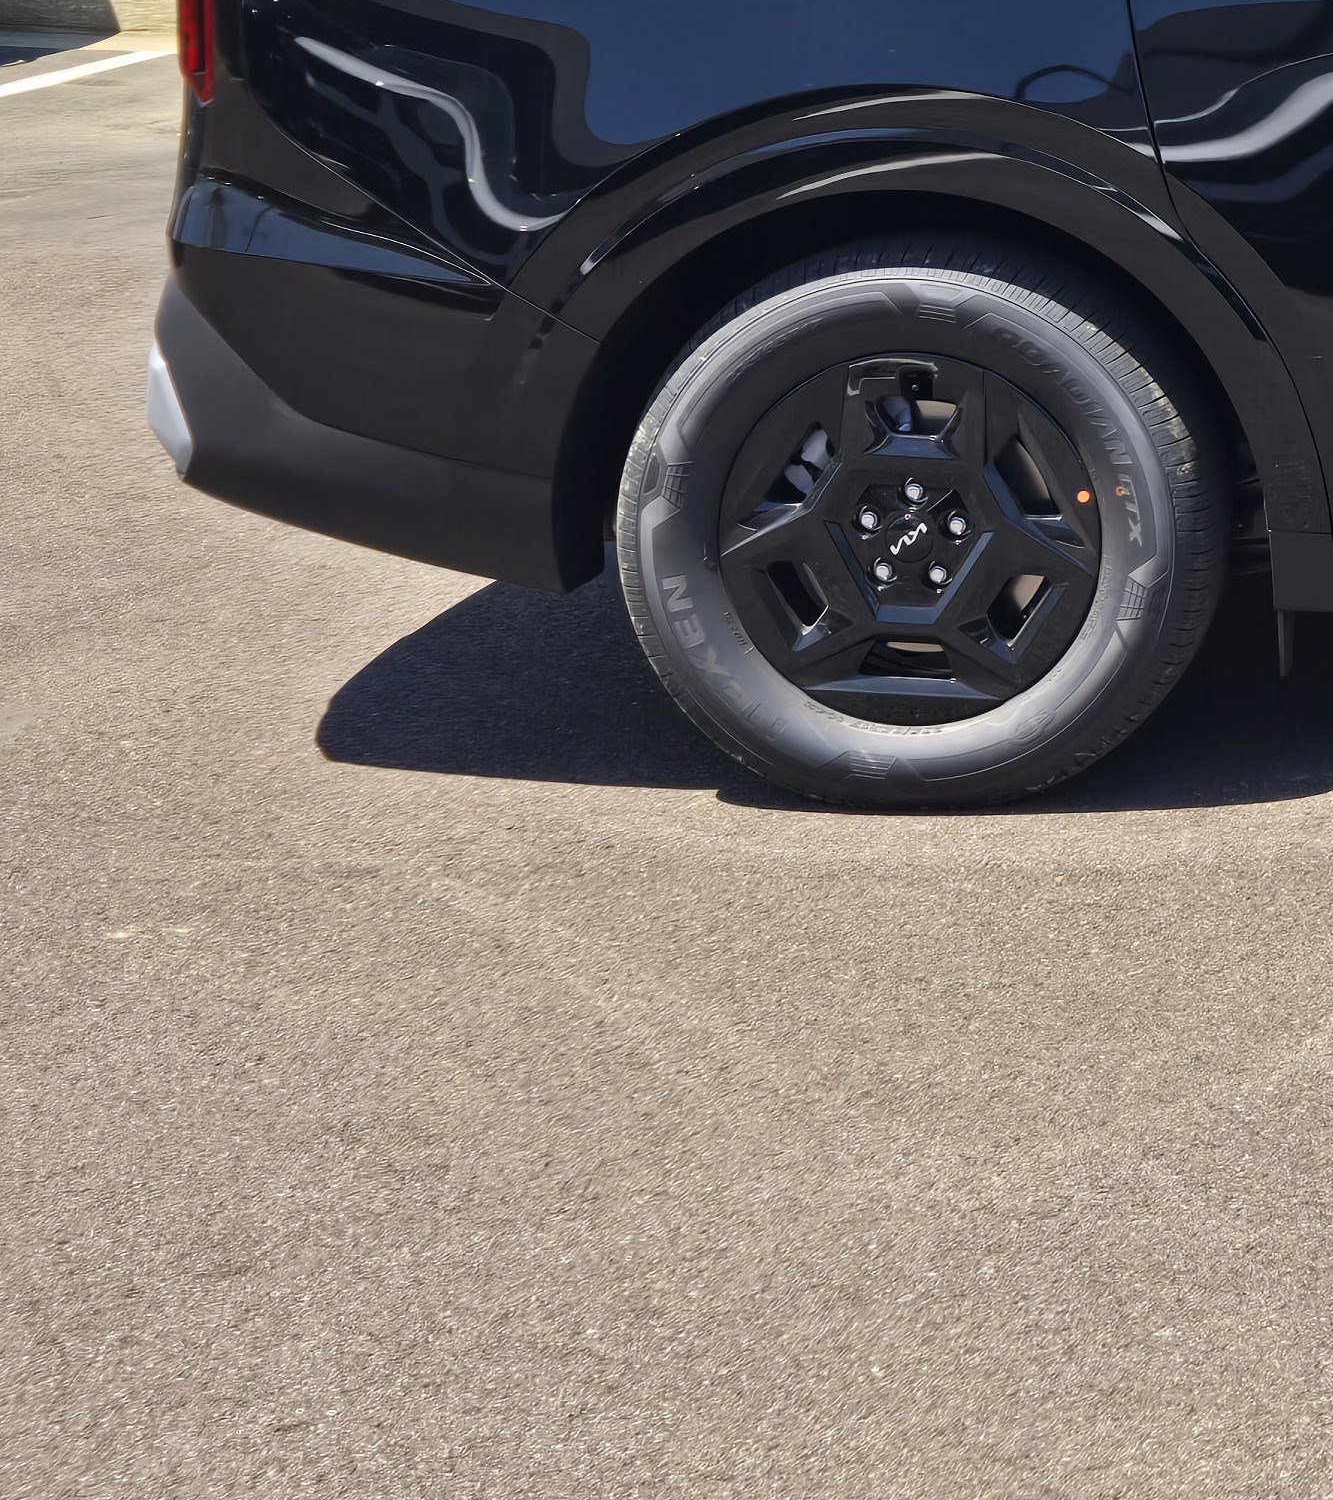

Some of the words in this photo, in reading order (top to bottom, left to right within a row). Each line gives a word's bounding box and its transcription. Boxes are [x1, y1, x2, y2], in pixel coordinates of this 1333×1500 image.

[889, 522, 928, 556] KIA
[1116, 473, 1143, 548] GTX
[661, 574, 790, 742] NEXEN
